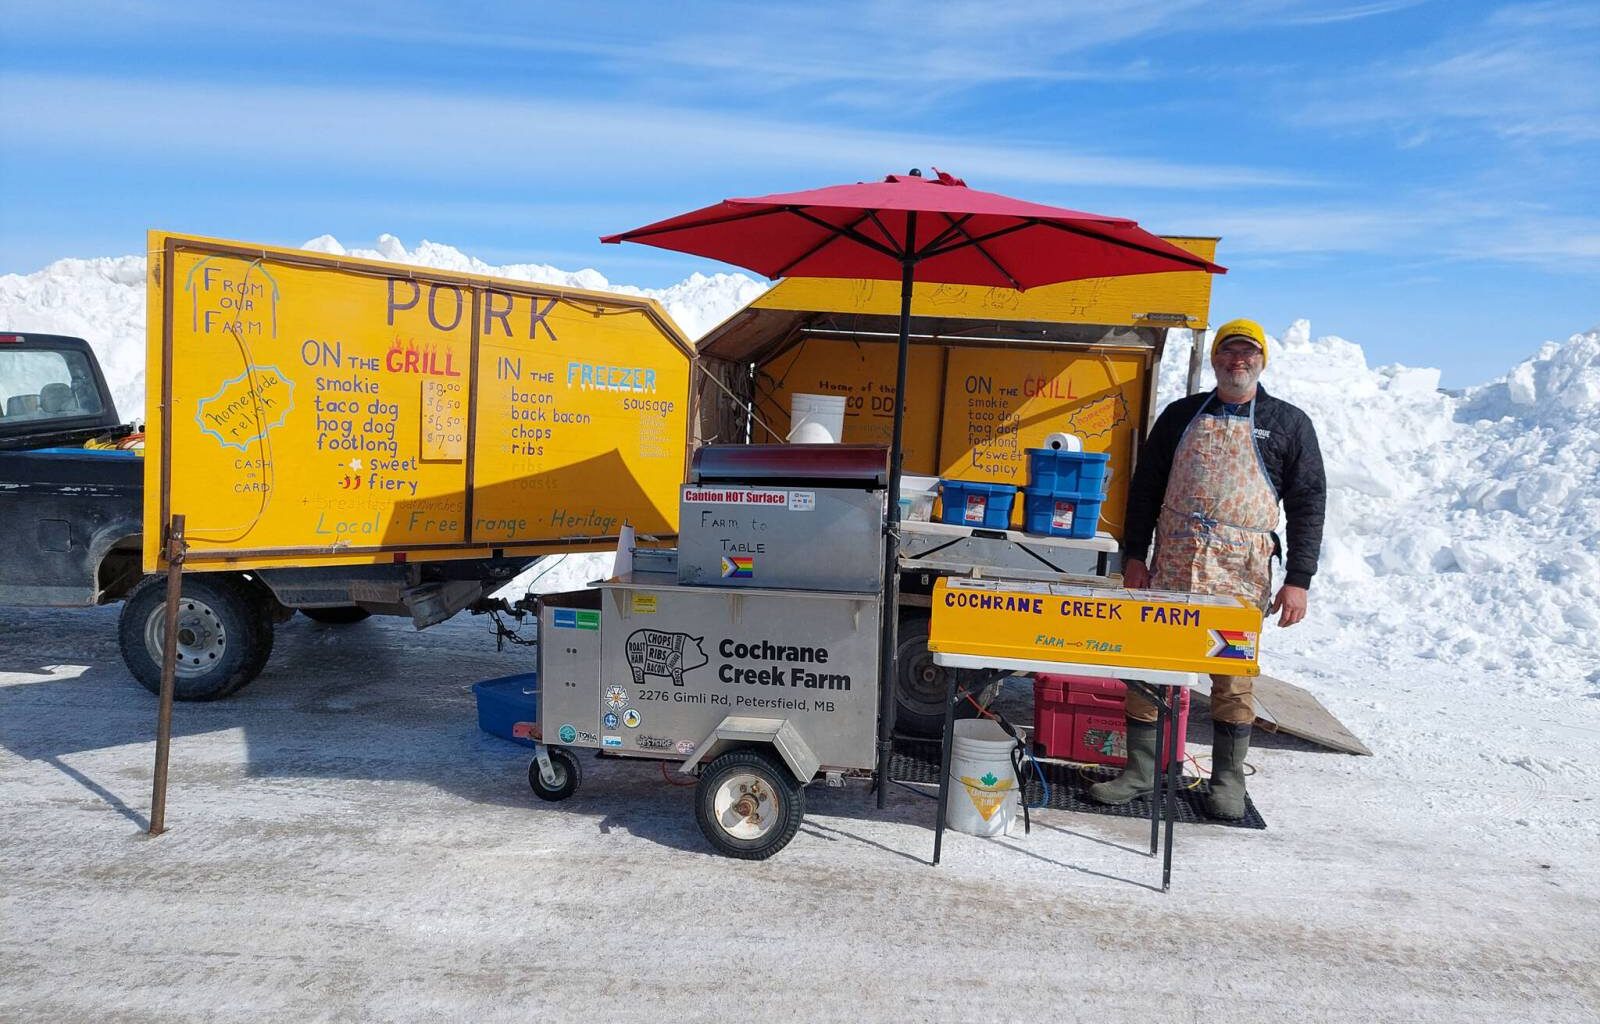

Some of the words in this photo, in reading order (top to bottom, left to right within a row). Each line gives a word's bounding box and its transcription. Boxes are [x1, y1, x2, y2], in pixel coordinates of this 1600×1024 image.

[204, 268, 264, 297] FROM
[220, 297, 254, 311] OUR
[387, 277, 558, 341] PORK
[204, 311, 262, 335] FARM
[302, 340, 341, 368] ON
[348, 357, 380, 371] THE
[386, 347, 461, 377] GRILL
[316, 374, 379, 394] smokie
[497, 356, 521, 380] IN
[531, 372, 554, 383] THE
[566, 361, 657, 393] FREEZER
[965, 375, 992, 394] ON
[1000, 387, 1018, 397] THE
[1023, 378, 1078, 400] GRILL
[314, 395, 360, 414] taco
[367, 399, 399, 421] dog
[511, 386, 553, 404] bacon
[623, 398, 674, 417] sausage
[968, 397, 1009, 409] smokie
[511, 405, 546, 421] back
[553, 408, 591, 424] bacon
[968, 410, 995, 421] taco
[998, 411, 1020, 427] dog
[316, 414, 353, 438] hog
[363, 418, 396, 440] dog
[511, 424, 552, 441] chops
[968, 422, 991, 439] hog
[996, 423, 1018, 440] dog
[316, 433, 398, 458] footlong
[511, 442, 544, 456] ribs
[234, 459, 272, 469] CASH
[370, 456, 418, 471] sweet
[985, 451, 1023, 462] sweet
[984, 463, 1018, 478] spicy
[234, 483, 270, 493] CARD
[368, 473, 419, 495] fiery
[685, 490, 724, 503] Caution
[725, 491, 744, 503] HOT
[746, 492, 785, 504] Surface
[316, 512, 381, 534] Local
[408, 511, 458, 532] Free
[475, 515, 528, 538] range
[551, 508, 618, 535] Heritage
[720, 539, 765, 554] TABLE
[944, 592, 1043, 615] COCHRANE
[1060, 600, 1122, 620] CREEK
[1140, 606, 1200, 627] FARM
[629, 642, 646, 652] ROAST
[648, 633, 671, 646] CHOPS
[1034, 634, 1065, 648] FARM
[1086, 639, 1122, 653] TABLE
[649, 647, 666, 660] RIBS
[719, 639, 828, 664] Cochrane
[647, 662, 665, 674] BACON
[719, 664, 785, 687] Creek
[791, 668, 850, 691] Farm
[639, 690, 669, 702] 2276
[674, 692, 706, 704] Gimli
[711, 694, 732, 707] Rd,
[736, 696, 810, 712] Petersfield,
[814, 700, 835, 713] MB
